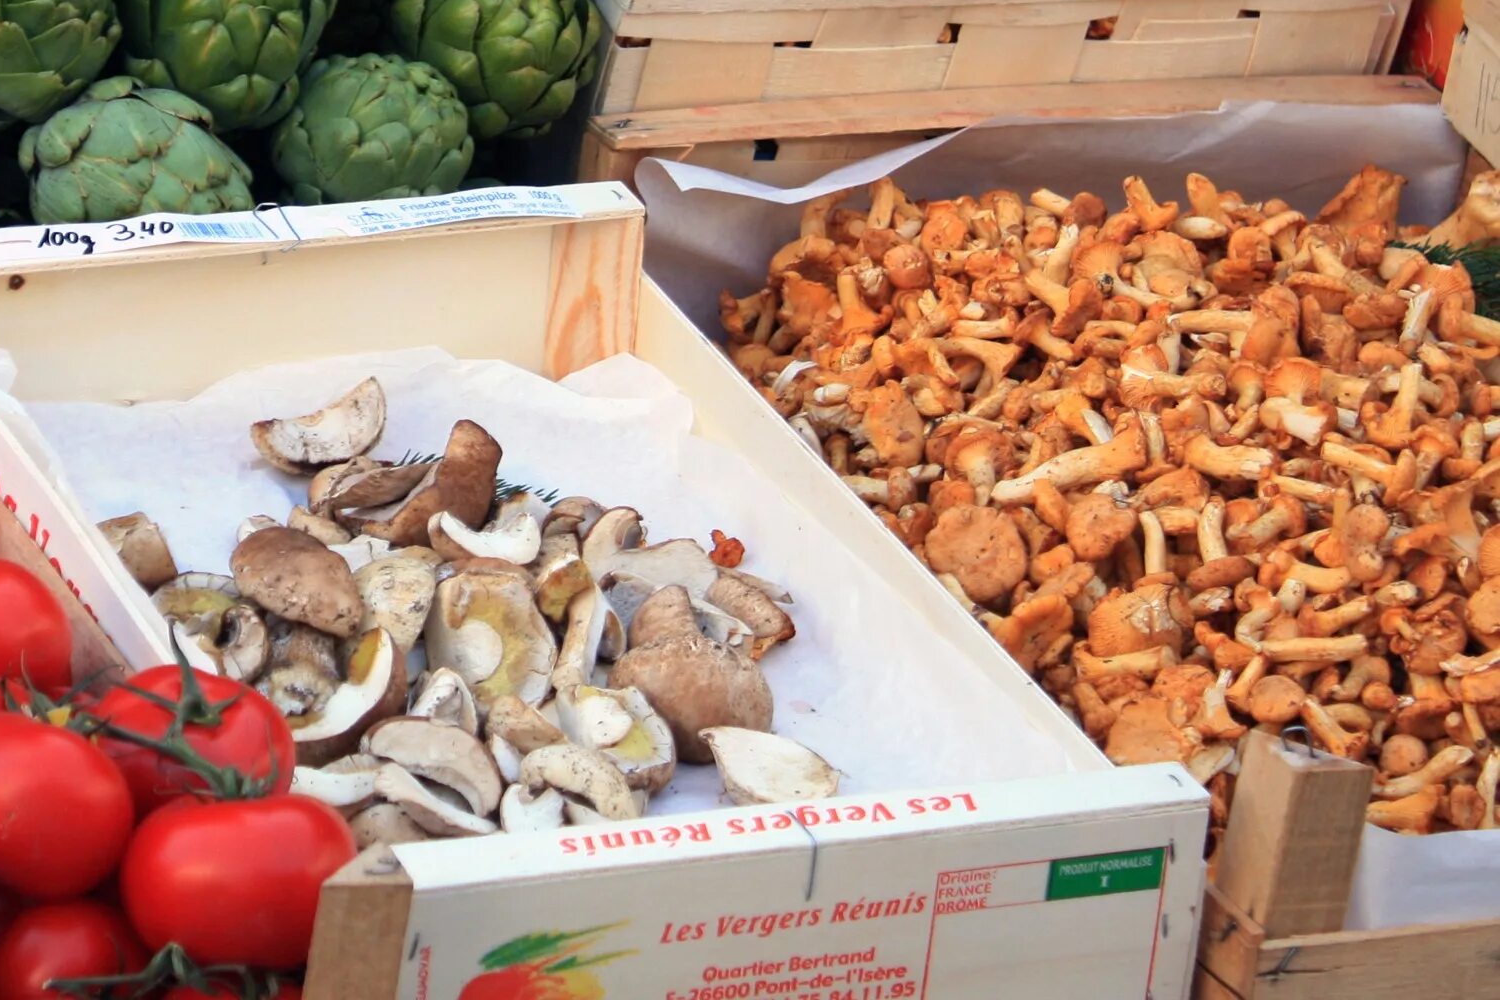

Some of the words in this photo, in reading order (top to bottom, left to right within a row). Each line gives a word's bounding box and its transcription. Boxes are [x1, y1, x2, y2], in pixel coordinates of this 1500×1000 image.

[399, 197, 451, 213] Frische
[451, 190, 518, 207] Steinpilze
[451, 202, 501, 216] Bayern
[37, 228, 96, 255] 100g
[105, 221, 174, 241] 3.40
[725, 801, 897, 837] Vergers
[906, 793, 979, 813] Les
[559, 822, 713, 857] Réunis
[1059, 861, 1100, 877] PRODUIT
[937, 882, 993, 900] FRANCE
[659, 921, 708, 944] Les
[716, 907, 823, 938] Vergers
[829, 890, 928, 924] Réunis
[702, 960, 785, 983] Quartier
[788, 946, 877, 973] Bertrand
[753, 965, 908, 997] Pont-de-l'Isère
